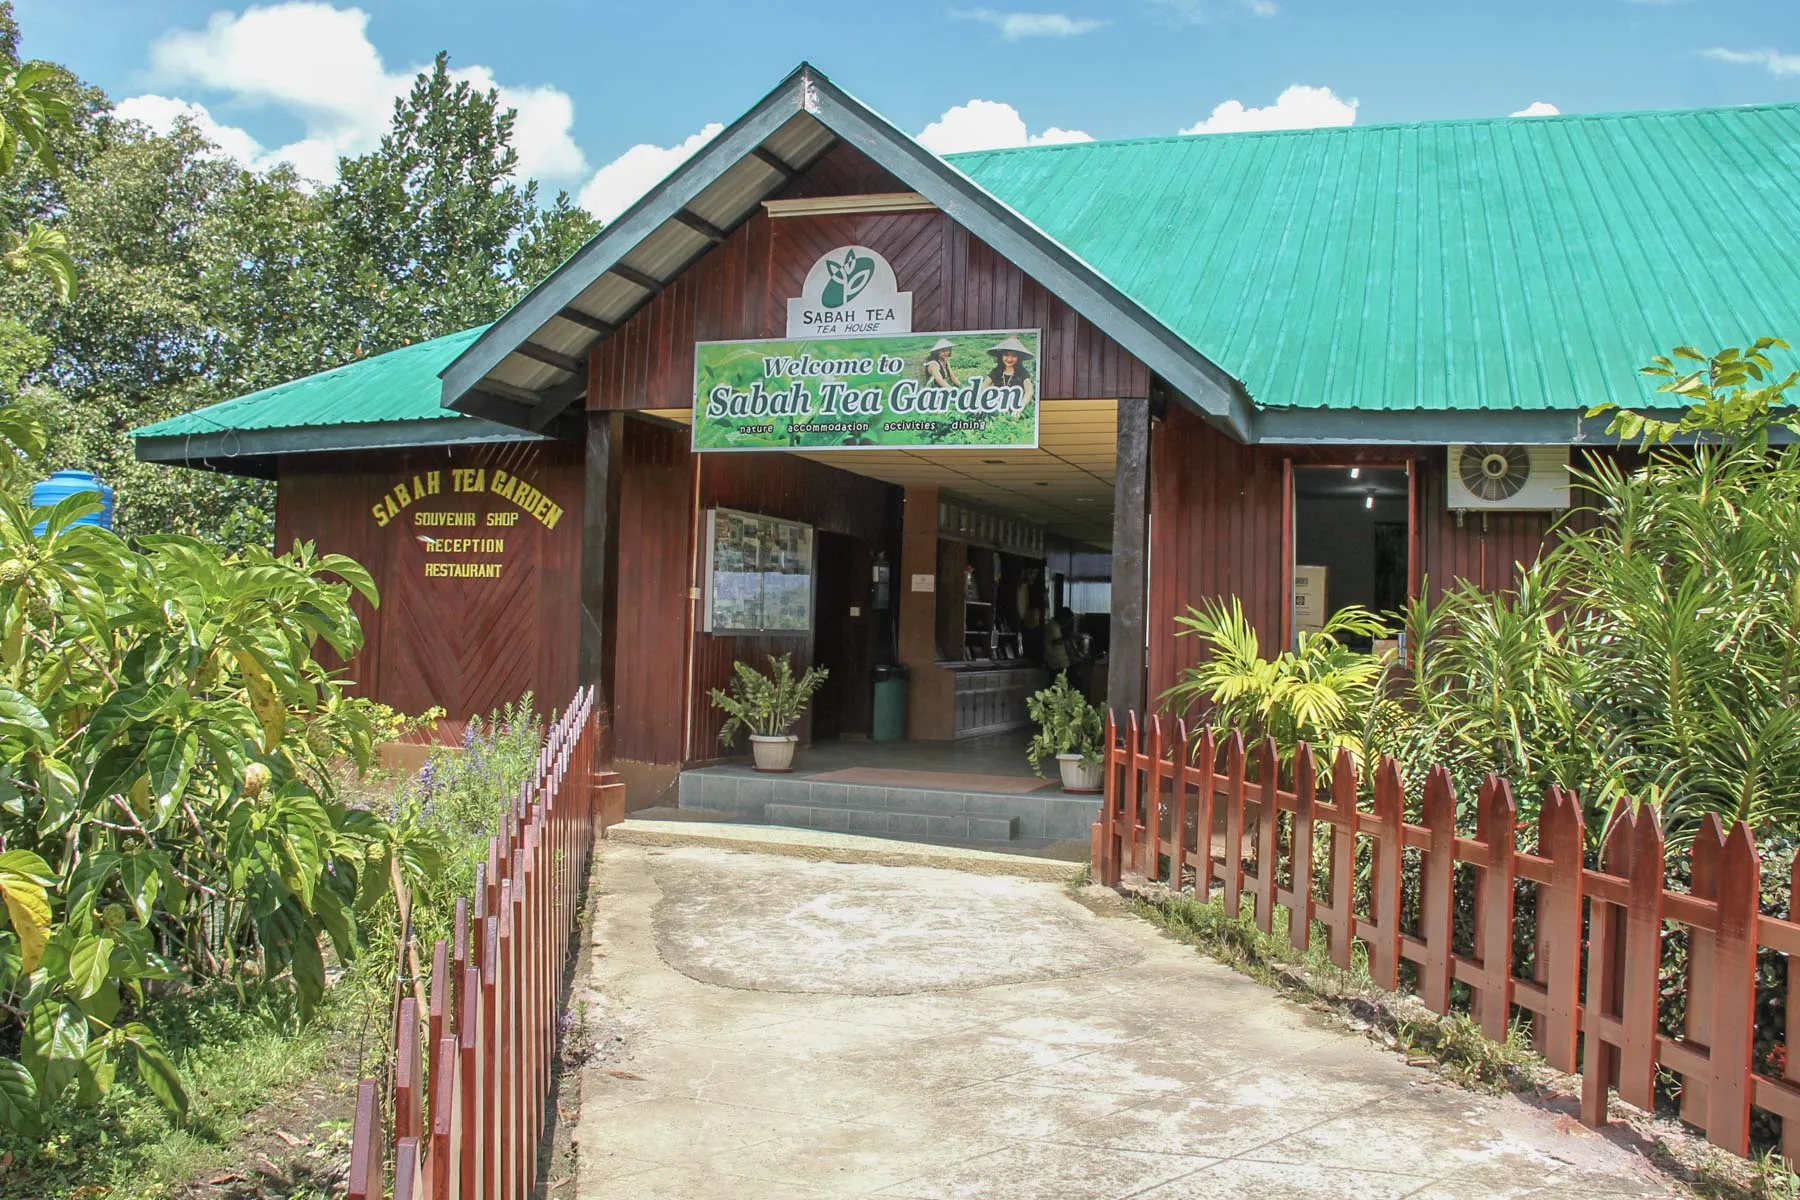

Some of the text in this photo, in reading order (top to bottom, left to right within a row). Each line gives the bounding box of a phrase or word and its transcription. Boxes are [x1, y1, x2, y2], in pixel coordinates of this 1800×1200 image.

[802, 308, 896, 325] SABAH TEA
[816, 322, 881, 334] TEA HOUSE
[763, 354, 903, 377] Welcome to
[707, 377, 1024, 417] Sabah Tea Garden
[740, 419, 986, 434] nature accommodation activities dining
[371, 468, 564, 530] SABAH TEA GARDEN
[414, 512, 519, 527] SOUVENIR SHOP
[426, 538, 504, 553] RECEPTION
[425, 563, 503, 578] RESTAURANT
